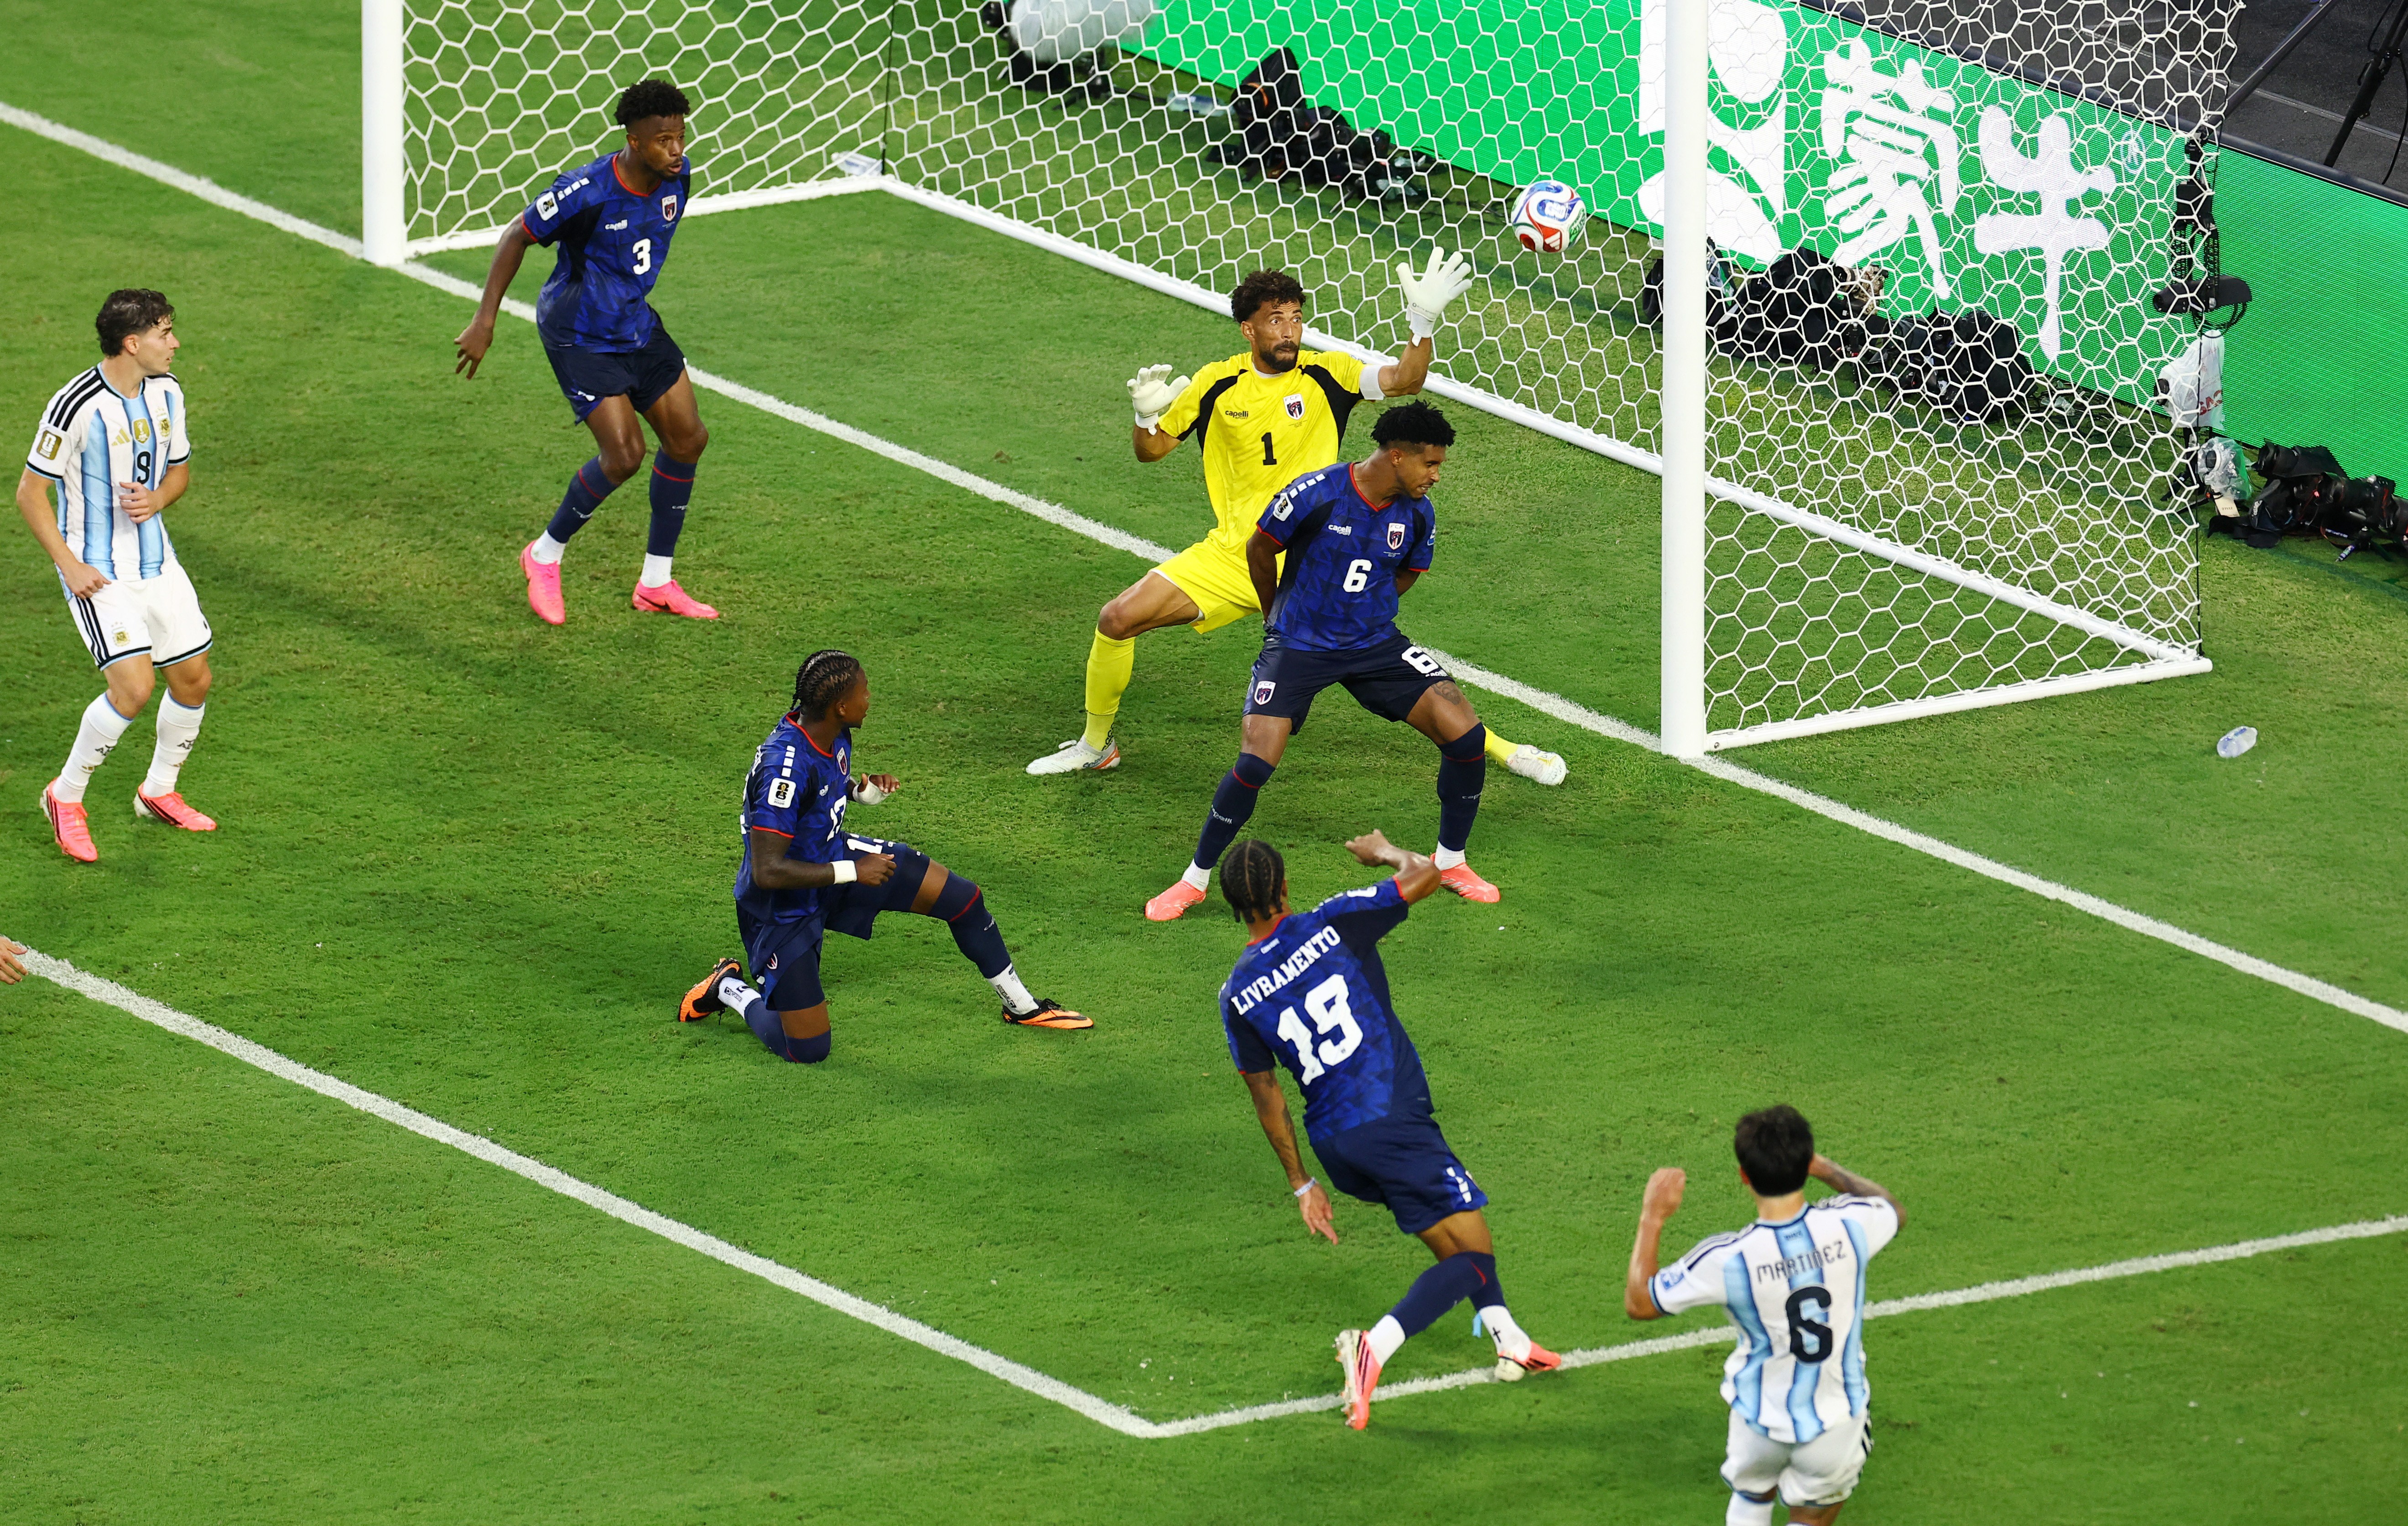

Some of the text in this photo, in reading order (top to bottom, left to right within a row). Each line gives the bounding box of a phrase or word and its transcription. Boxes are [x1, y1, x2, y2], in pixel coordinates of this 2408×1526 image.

[1820, 38, 2117, 360] 蒙牛
[633, 238, 651, 275] 3
[137, 451, 151, 484] 9
[1261, 432, 1277, 466] 1
[1328, 524, 1352, 534] capelli
[1343, 559, 1372, 592] 6
[1401, 646, 1439, 674] 6
[1231, 925, 1341, 1016] LIVRAMENTO
[1277, 973, 1363, 1086] 19
[1756, 1240, 1846, 1285] MARTINEZ
[1785, 1286, 1833, 1362] 6
